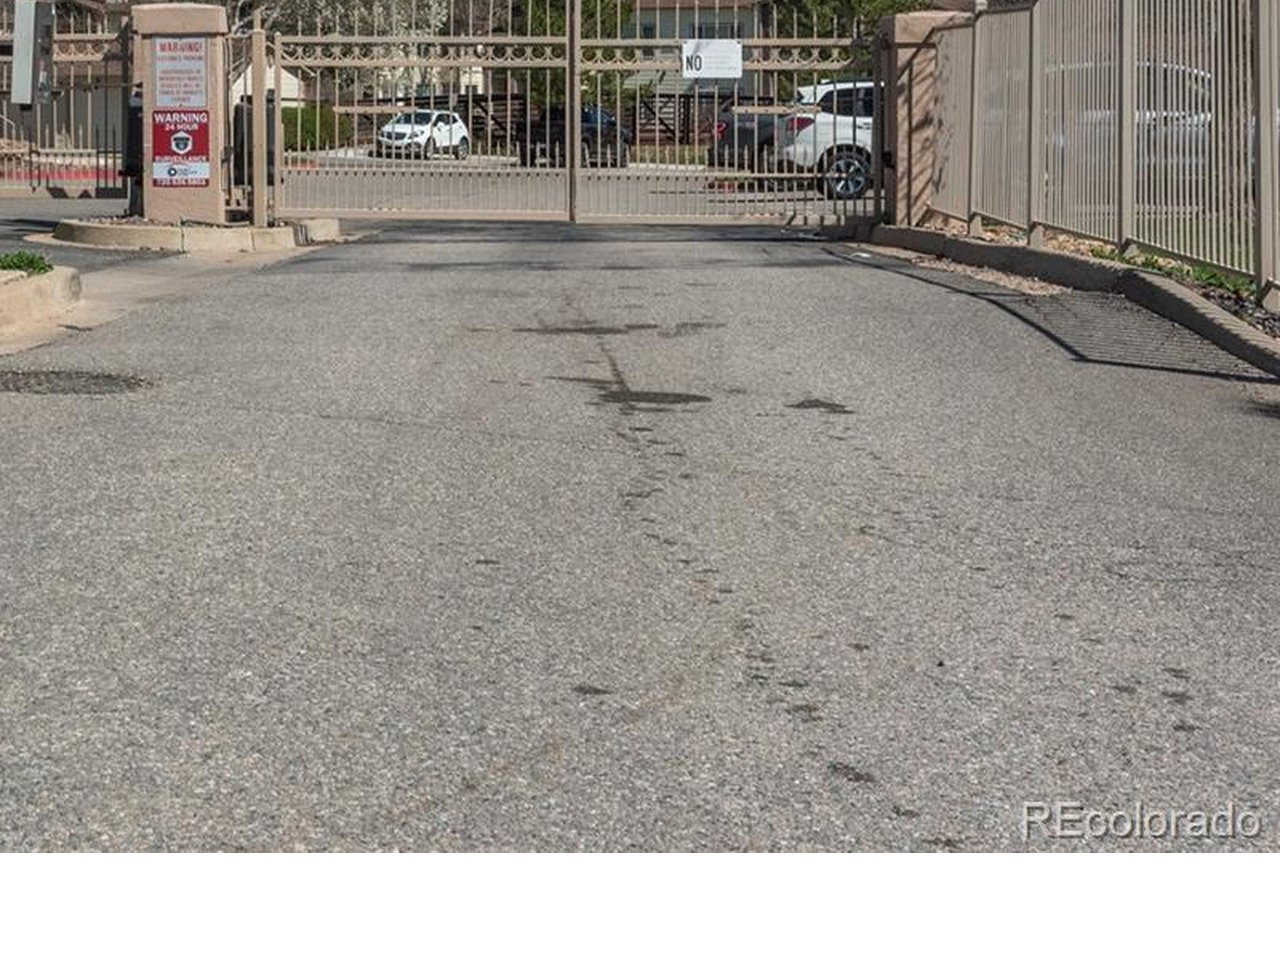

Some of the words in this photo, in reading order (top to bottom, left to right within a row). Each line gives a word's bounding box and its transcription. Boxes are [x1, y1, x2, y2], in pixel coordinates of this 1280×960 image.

[685, 54, 703, 72] NO
[154, 112, 208, 124] WARNING
[165, 123, 176, 131] 24
[176, 123, 199, 131] HOUR
